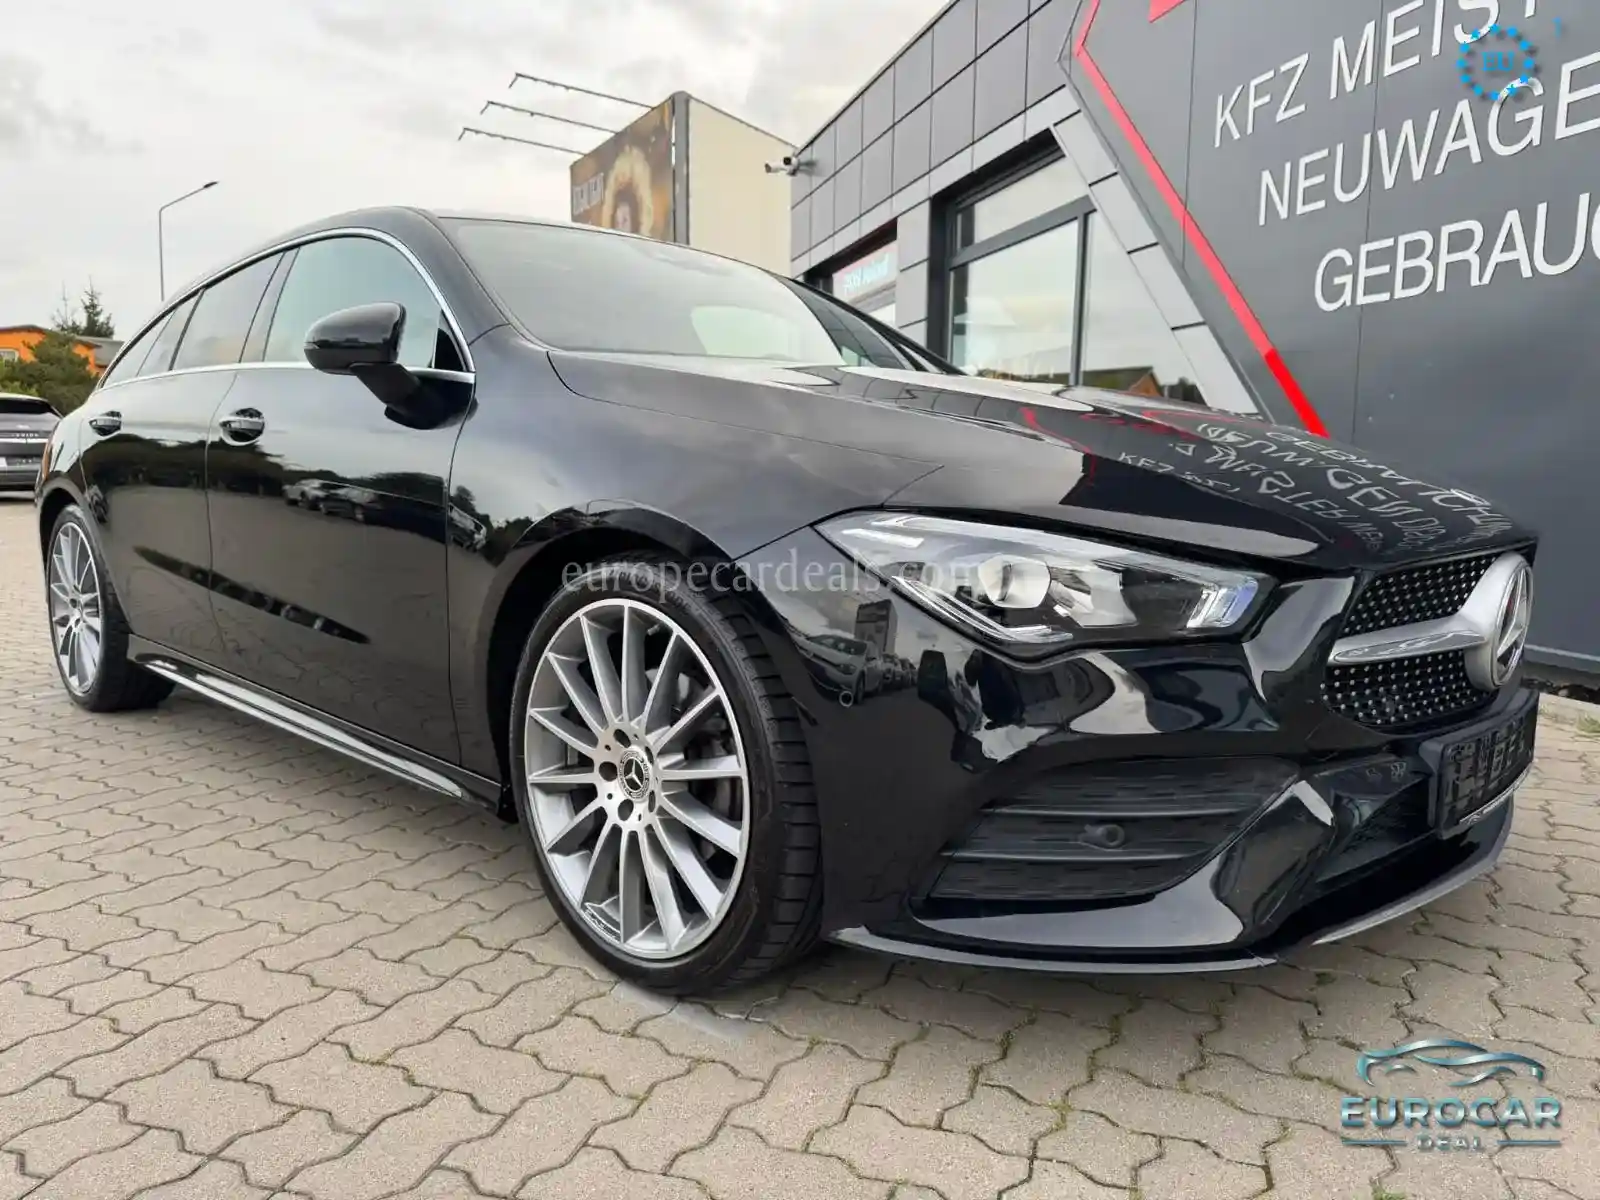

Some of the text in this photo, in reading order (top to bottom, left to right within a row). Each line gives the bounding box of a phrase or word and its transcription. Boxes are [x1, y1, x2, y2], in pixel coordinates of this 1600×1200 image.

[1214, 0, 1536, 148] KFZ MEIS
[1259, 52, 1600, 226] NEUWAGE
[1314, 193, 1600, 312] GEBRAU
